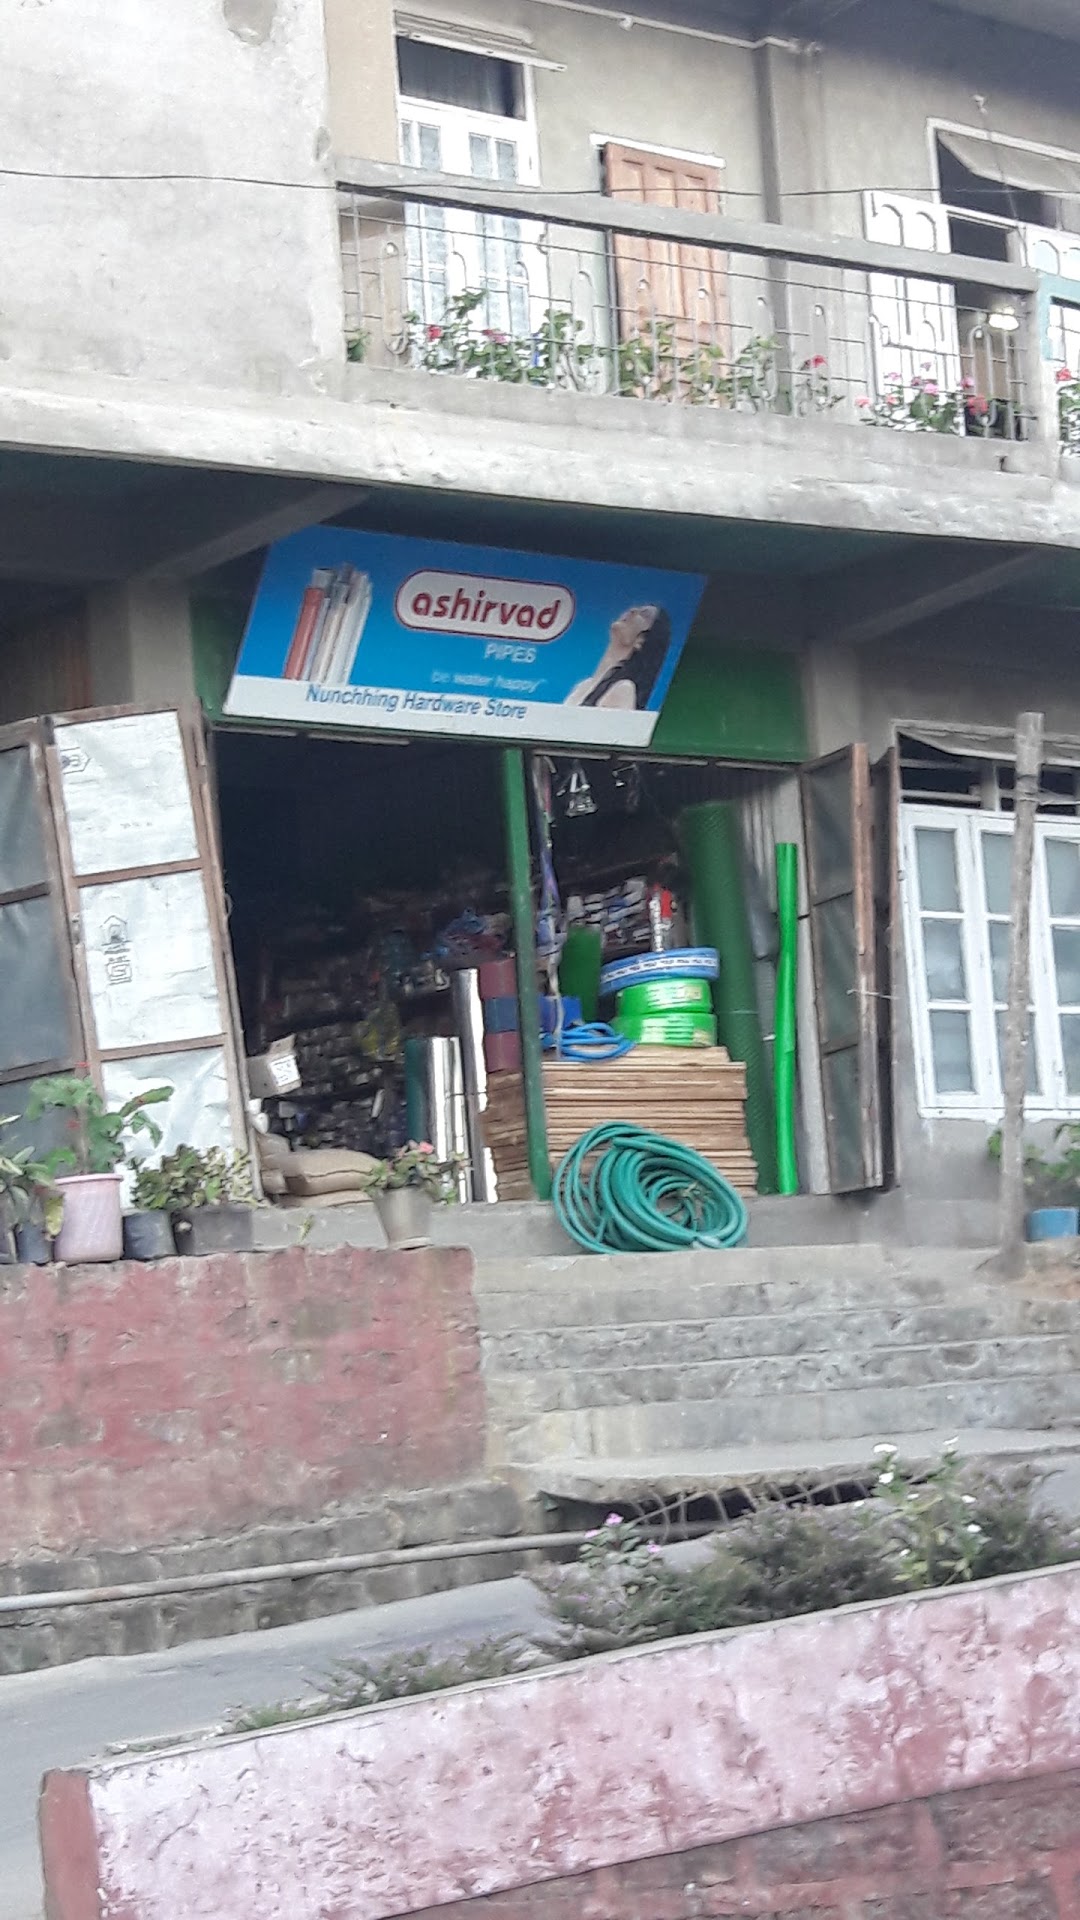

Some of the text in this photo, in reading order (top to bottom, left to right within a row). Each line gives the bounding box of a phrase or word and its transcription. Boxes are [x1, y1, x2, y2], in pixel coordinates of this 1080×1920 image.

[411, 587, 561, 629] ashirvad
[484, 643, 537, 663] PIPES
[306, 684, 527, 719] Nunchhing Hardware Store
